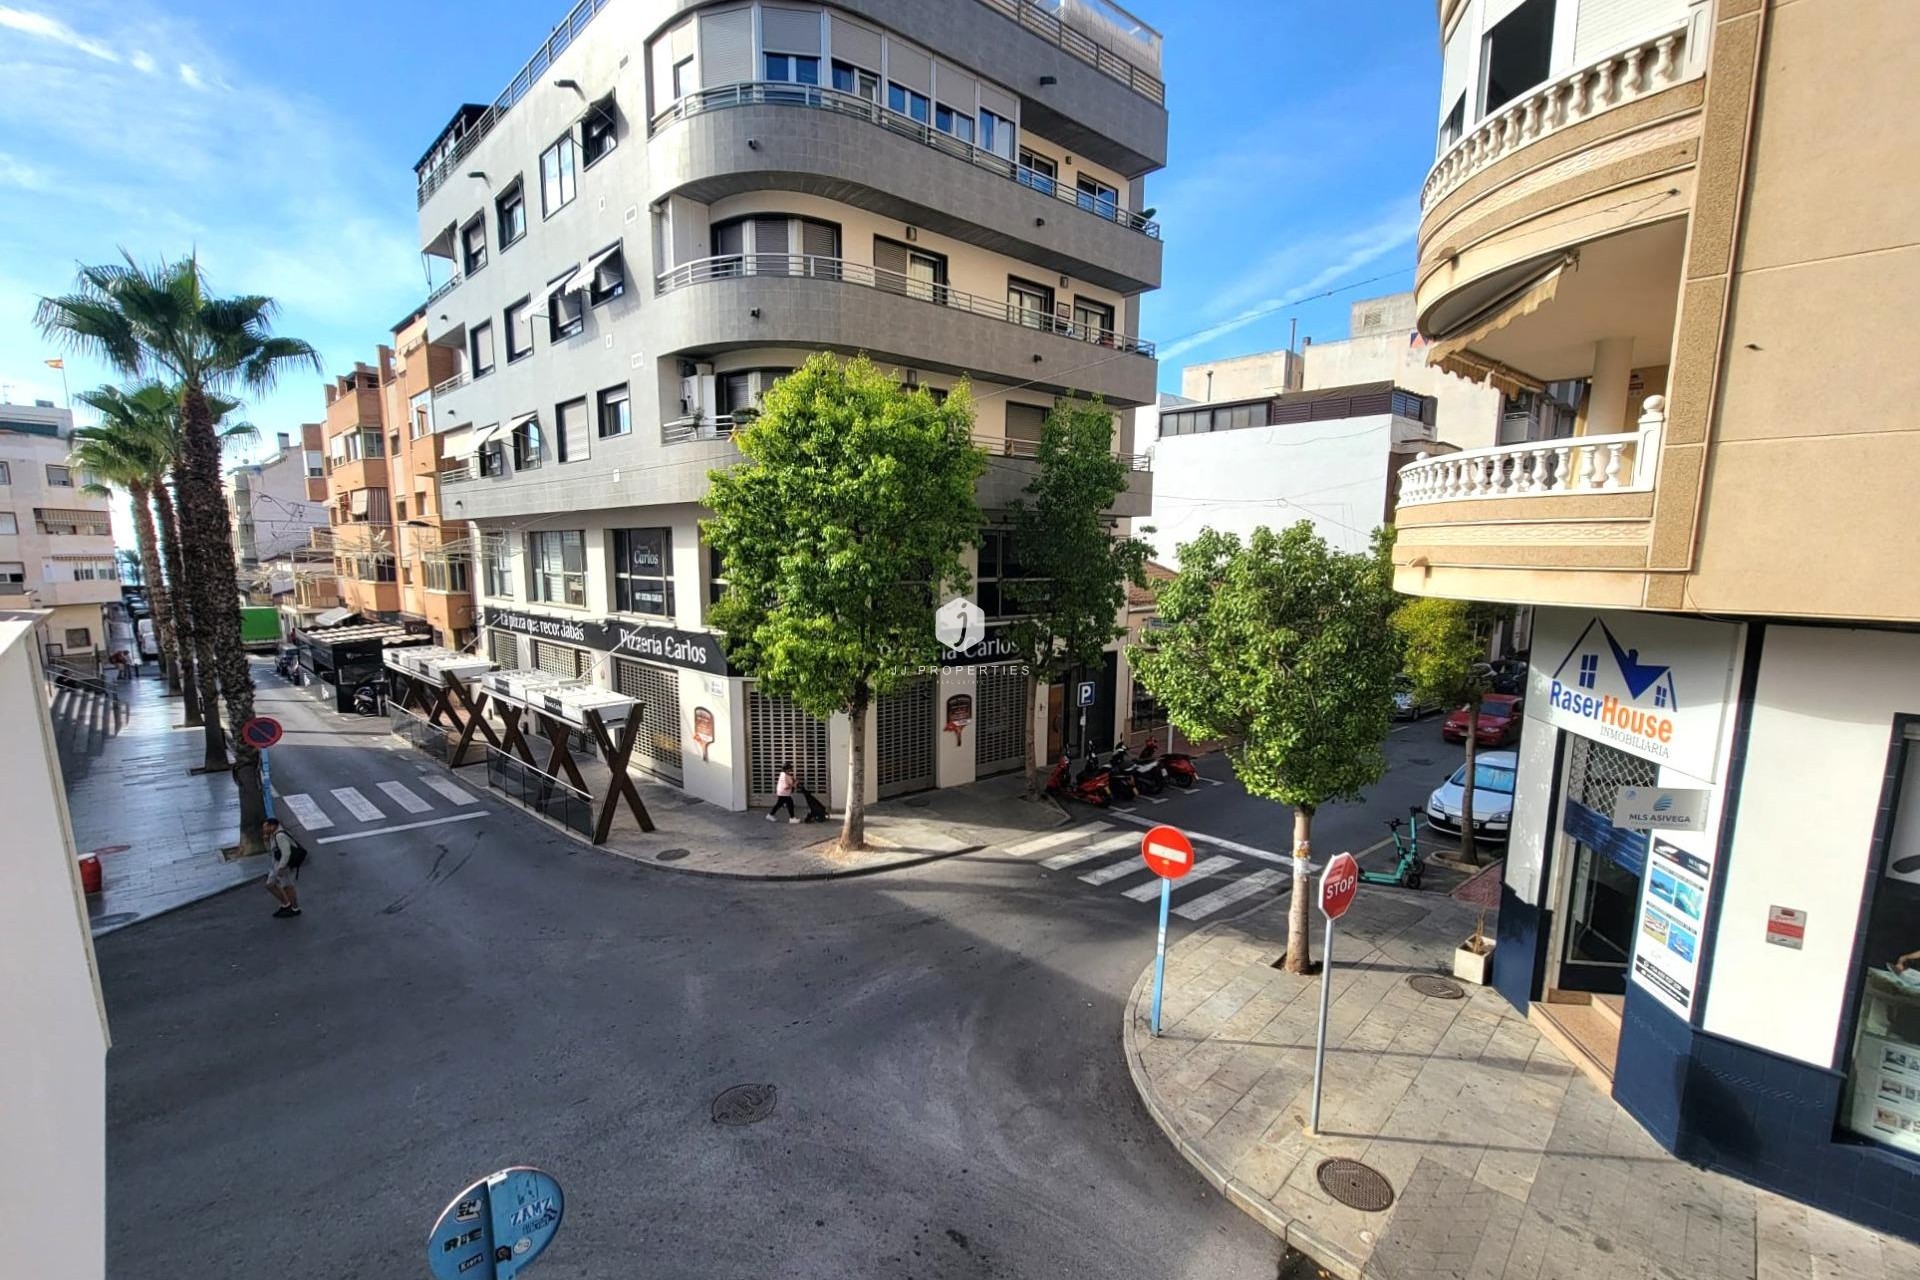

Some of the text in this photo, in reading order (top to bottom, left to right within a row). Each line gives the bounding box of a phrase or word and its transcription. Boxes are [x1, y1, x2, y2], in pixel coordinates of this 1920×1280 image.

[634, 550, 659, 565] Carlos
[508, 613, 526, 632] pizza
[526, 618, 540, 636] que
[619, 628, 706, 664] Pizzeria Carlos
[1081, 685, 1091, 703] P
[1550, 680, 1673, 743] RaserHouse
[1600, 725, 1670, 759] INMOBILIARIA
[1629, 813, 1691, 824] MLS ASIVEGA
[1326, 875, 1354, 899] STOP
